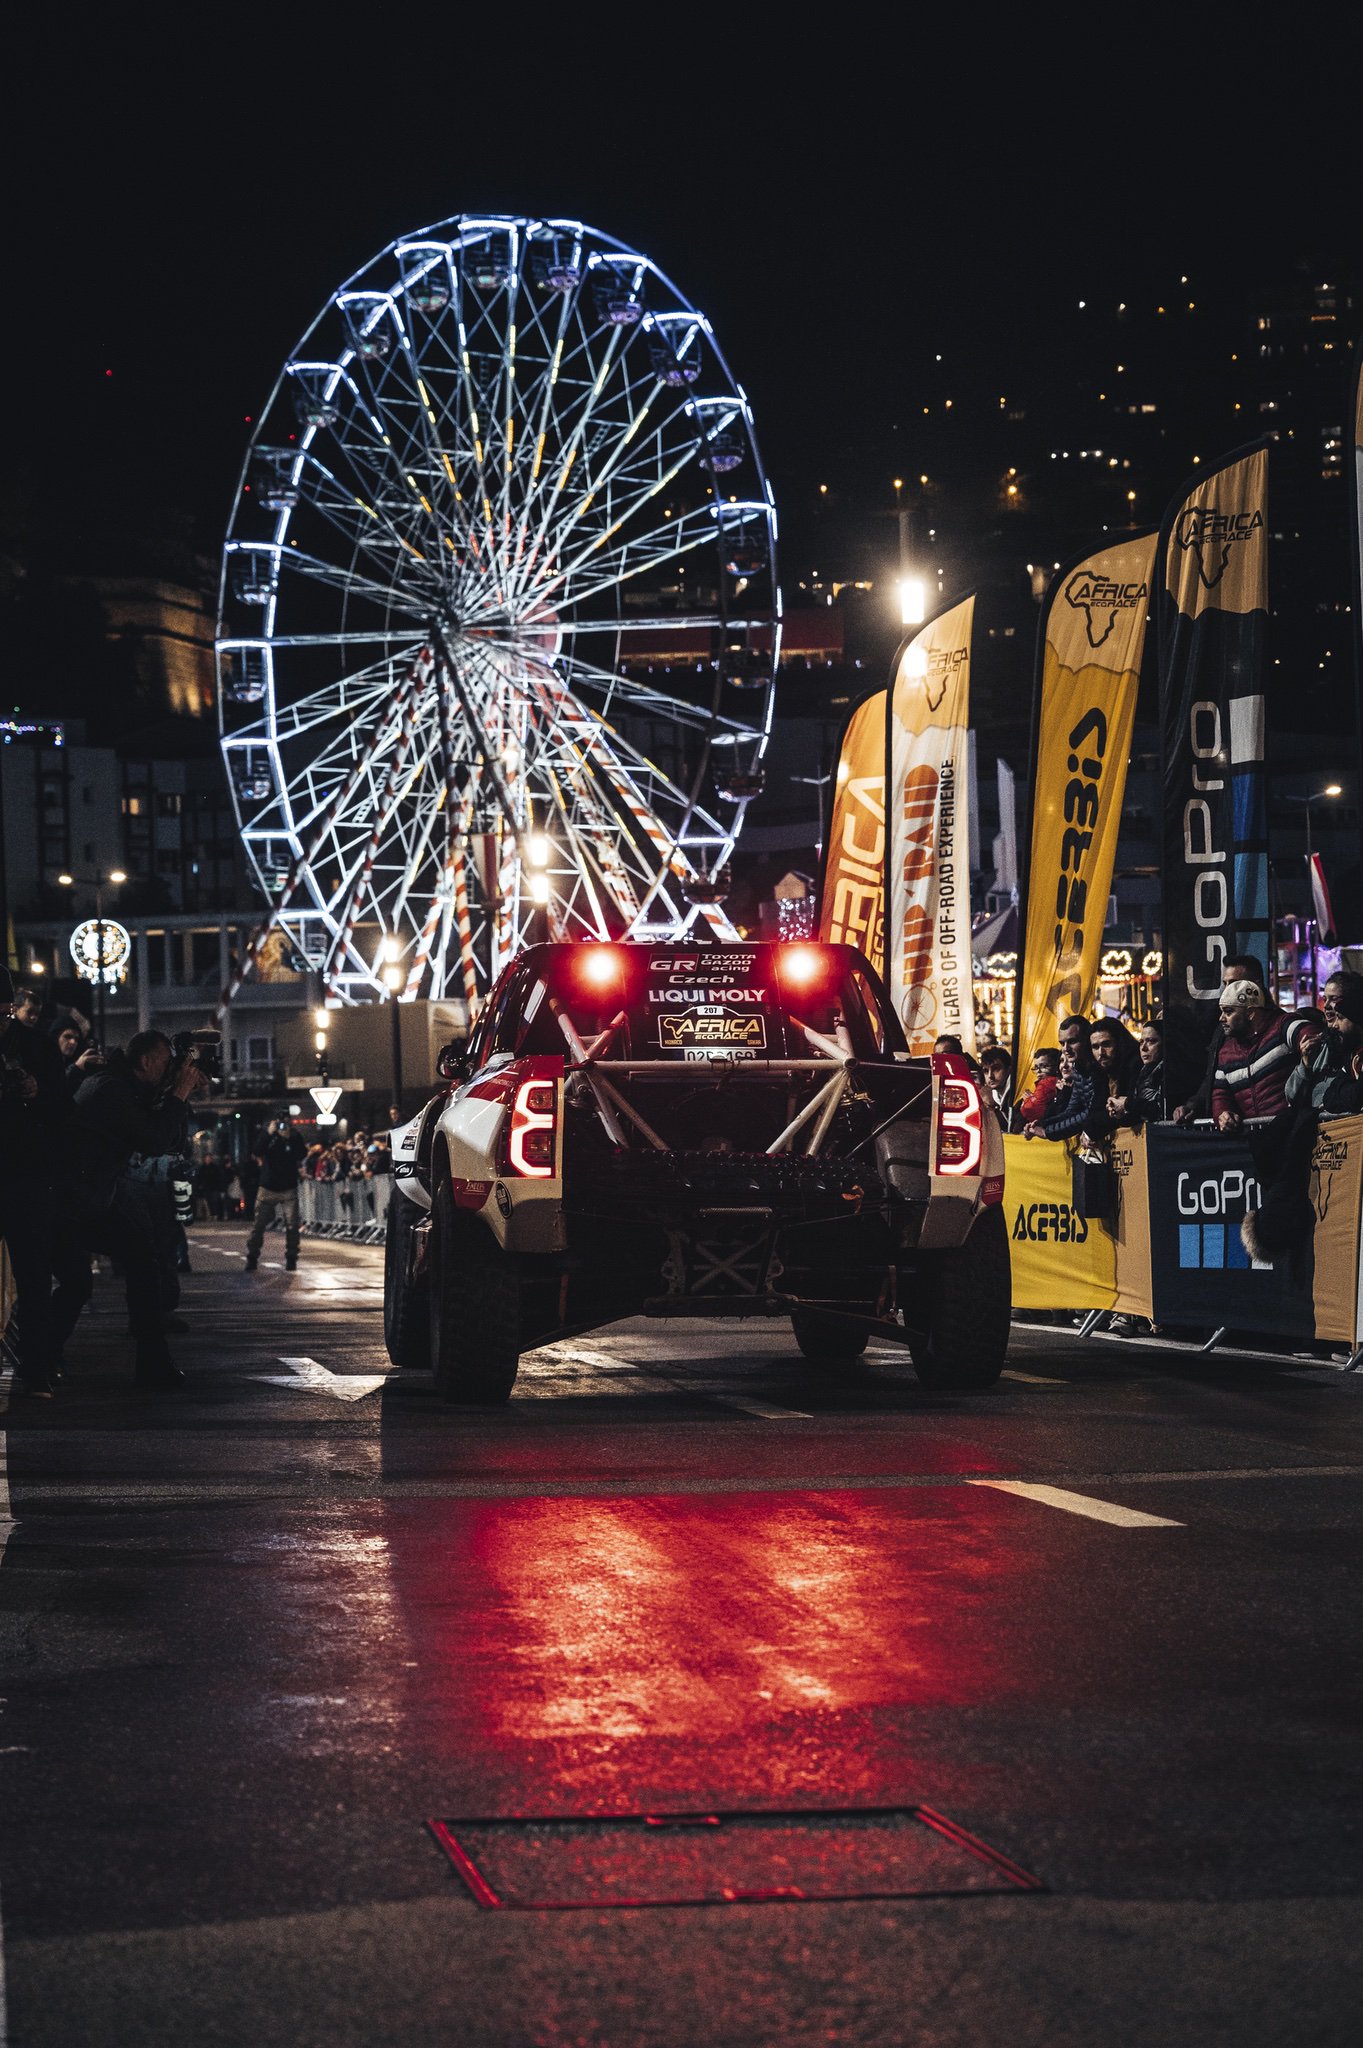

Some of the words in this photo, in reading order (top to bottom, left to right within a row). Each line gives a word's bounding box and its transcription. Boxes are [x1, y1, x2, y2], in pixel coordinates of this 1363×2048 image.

[1184, 510, 1263, 543] AFRICA
[1074, 583, 1147, 601] AFRICA
[927, 647, 968, 668] FRICA
[1184, 700, 1226, 1000] GoPro
[939, 863, 956, 945] OFF-ROAD
[650, 960, 696, 971] GR
[940, 950, 958, 972] OF
[669, 975, 735, 984] Czech
[649, 989, 705, 1003] LIQUI
[709, 989, 766, 1002] MOLY
[942, 976, 961, 1034] YEARS
[676, 1019, 760, 1035] AFRICA
